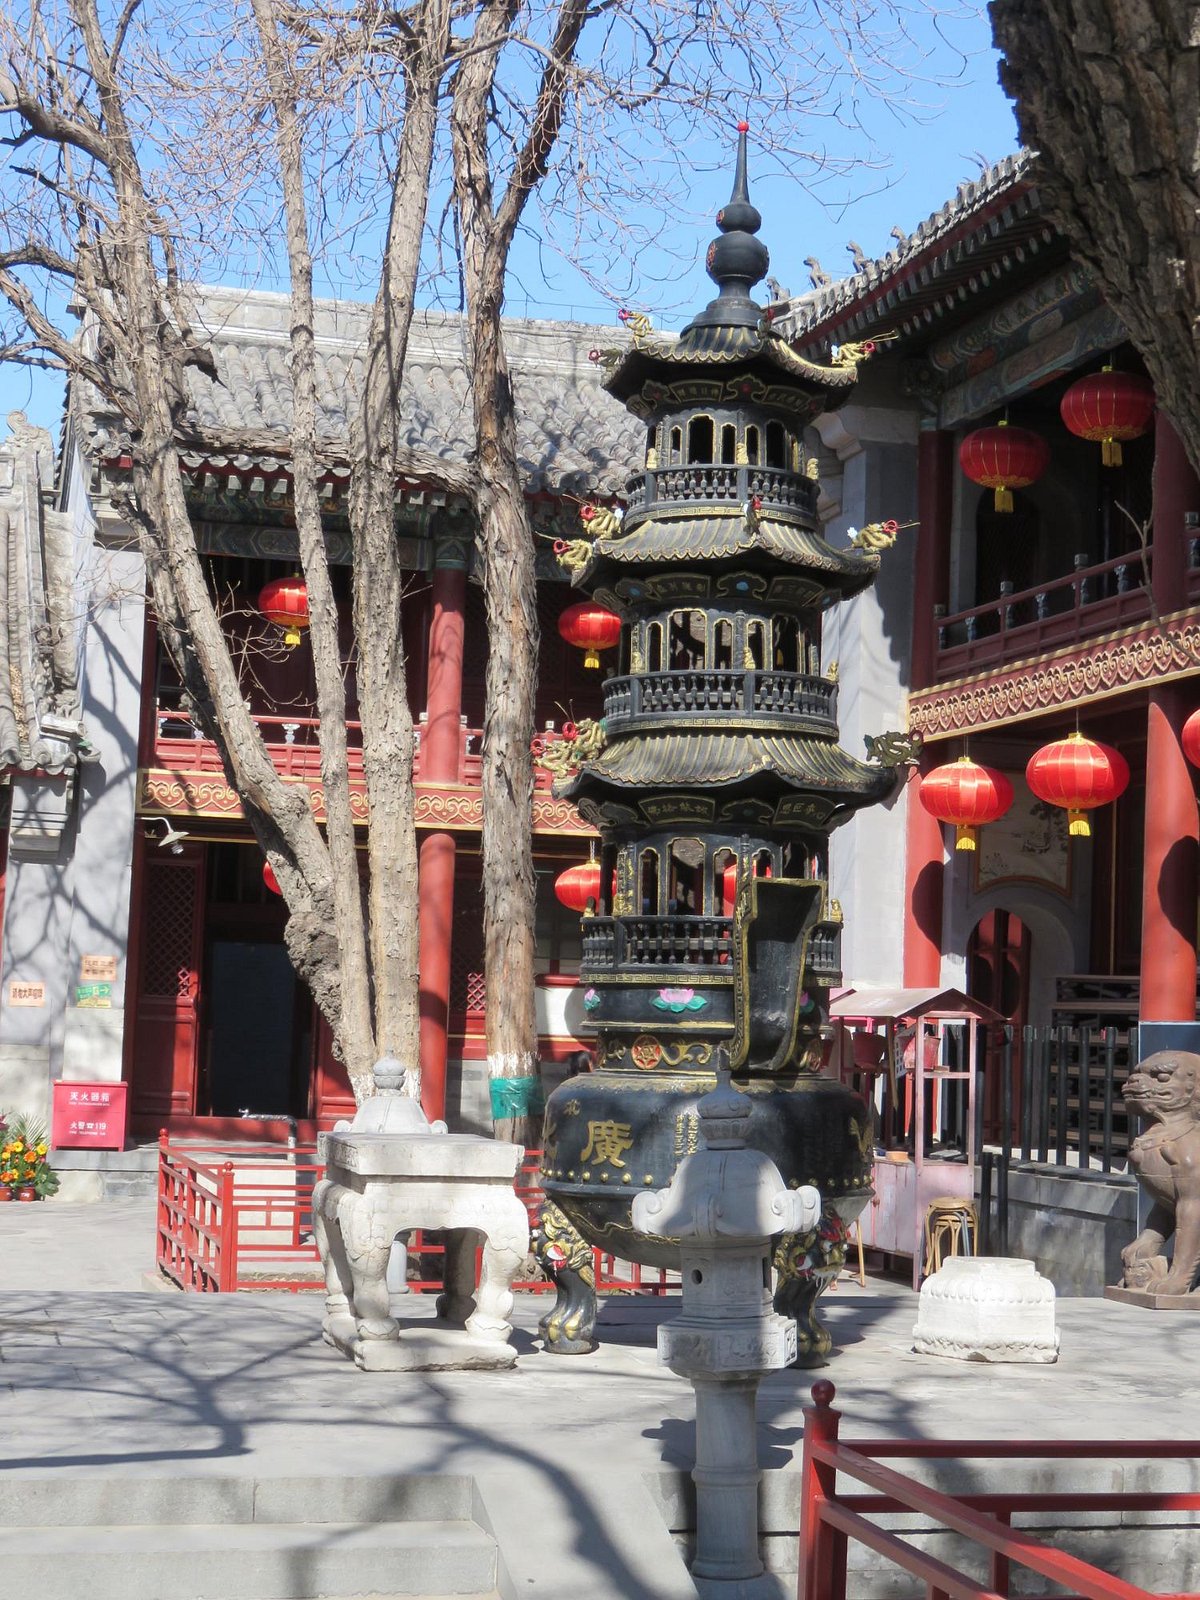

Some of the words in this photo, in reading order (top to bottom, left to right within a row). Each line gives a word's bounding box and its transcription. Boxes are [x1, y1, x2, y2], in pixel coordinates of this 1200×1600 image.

[70, 1091, 110, 1102] 灭火器箱
[580, 1120, 634, 1168] 廣
